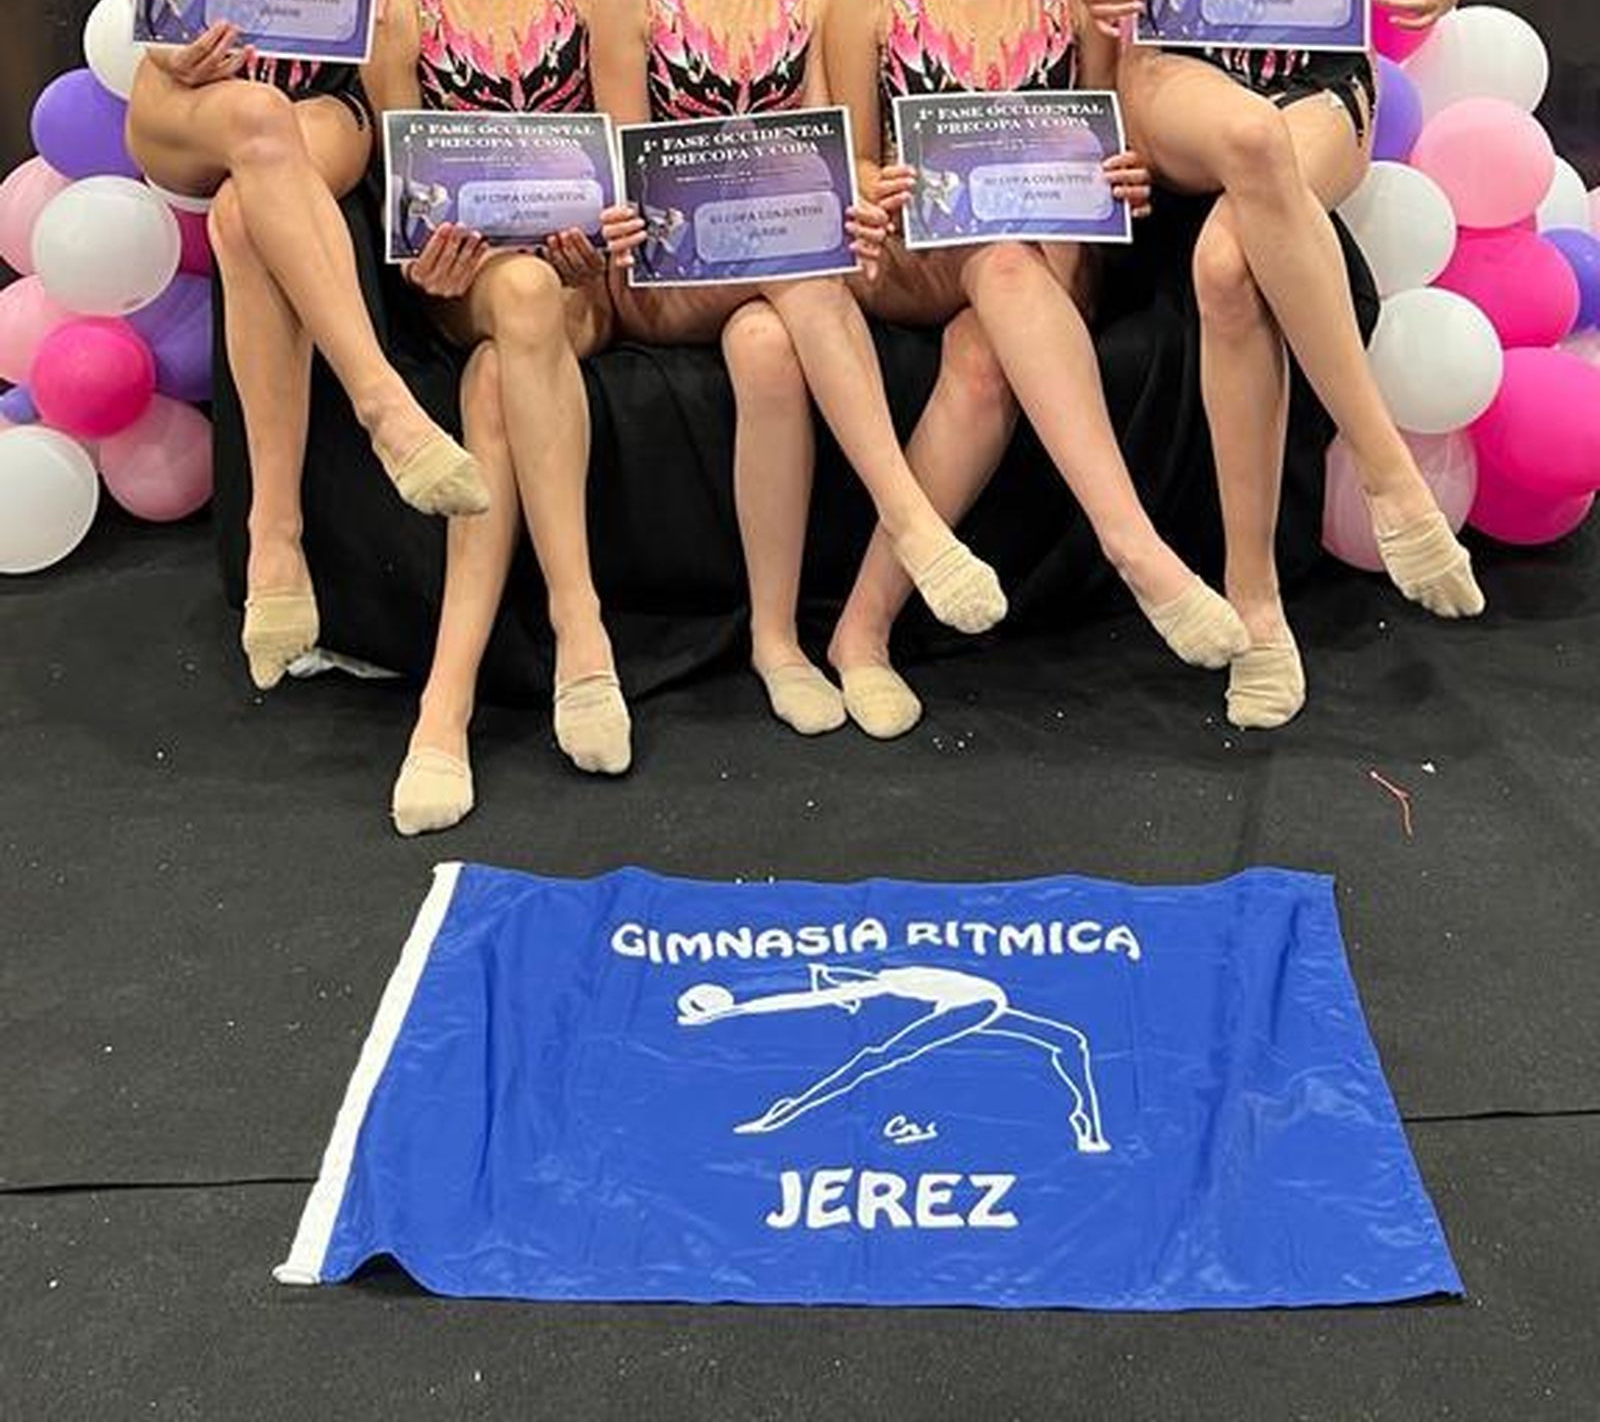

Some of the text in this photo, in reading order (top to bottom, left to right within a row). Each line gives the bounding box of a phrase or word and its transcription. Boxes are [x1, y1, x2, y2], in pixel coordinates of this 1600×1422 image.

[938, 106, 985, 120] FASE
[987, 104, 1104, 117] OCCIDENTAL
[428, 124, 475, 135] FASE
[478, 124, 595, 136] OCCIDENTAL
[936, 116, 1090, 134] PRECOPA Y COPA
[427, 137, 582, 149] PRECOPA Y COPA
[662, 134, 710, 151] FASE
[713, 123, 835, 145] OCCIDENTAL
[661, 141, 819, 167] PRECOPA Y COPA
[610, 917, 1141, 964] GIMNASIA RITMICA
[765, 1168, 1020, 1230] JEREZ
